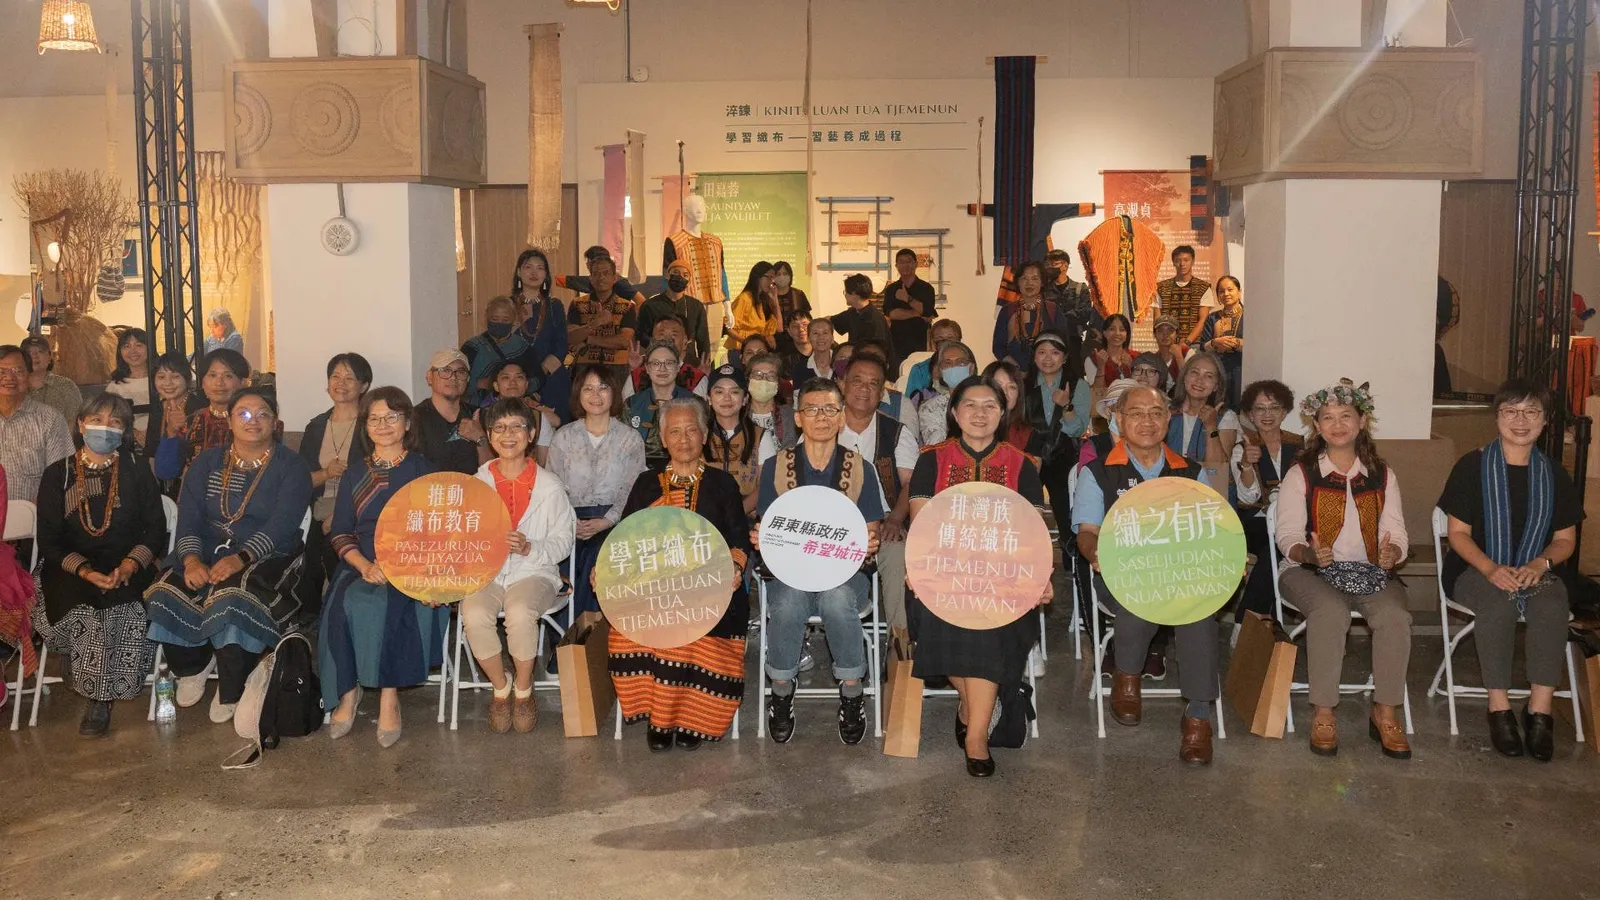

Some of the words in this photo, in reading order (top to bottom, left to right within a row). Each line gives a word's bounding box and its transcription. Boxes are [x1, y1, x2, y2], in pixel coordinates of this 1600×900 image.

[764, 105, 849, 117] KINITLUAN
[854, 104, 880, 116] TUA
[886, 103, 958, 117] TJEMENUN
[725, 212, 772, 222] VALJILET
[428, 484, 464, 507] 推動
[405, 509, 482, 533] 織布教育
[950, 494, 1011, 524] 排灣族
[768, 515, 849, 542] 屏東縣政府
[1112, 499, 1223, 548] 織之有序
[395, 540, 491, 552] PASEZURUNG
[802, 539, 866, 562] 希望城市
[938, 522, 1020, 555] 傳統織布
[400, 552, 485, 564] PALJIYAZUA
[609, 530, 712, 576] 學習織布
[1118, 547, 1224, 572] SASELJUDJAN
[427, 564, 456, 575] TUA
[922, 554, 1034, 579] TJEMENUN
[1112, 574, 1143, 590] TUA
[1149, 562, 1236, 586] TJEMENUN
[402, 576, 480, 589] TJEMENUN
[605, 571, 721, 600] KINITULUAN
[951, 576, 996, 594] NUA
[1125, 589, 1163, 605] NUA
[1166, 580, 1230, 600] PAIWAN
[645, 593, 685, 611] TUA
[935, 592, 1016, 614] PAIWAN
[618, 604, 720, 633] TJEMENUN
